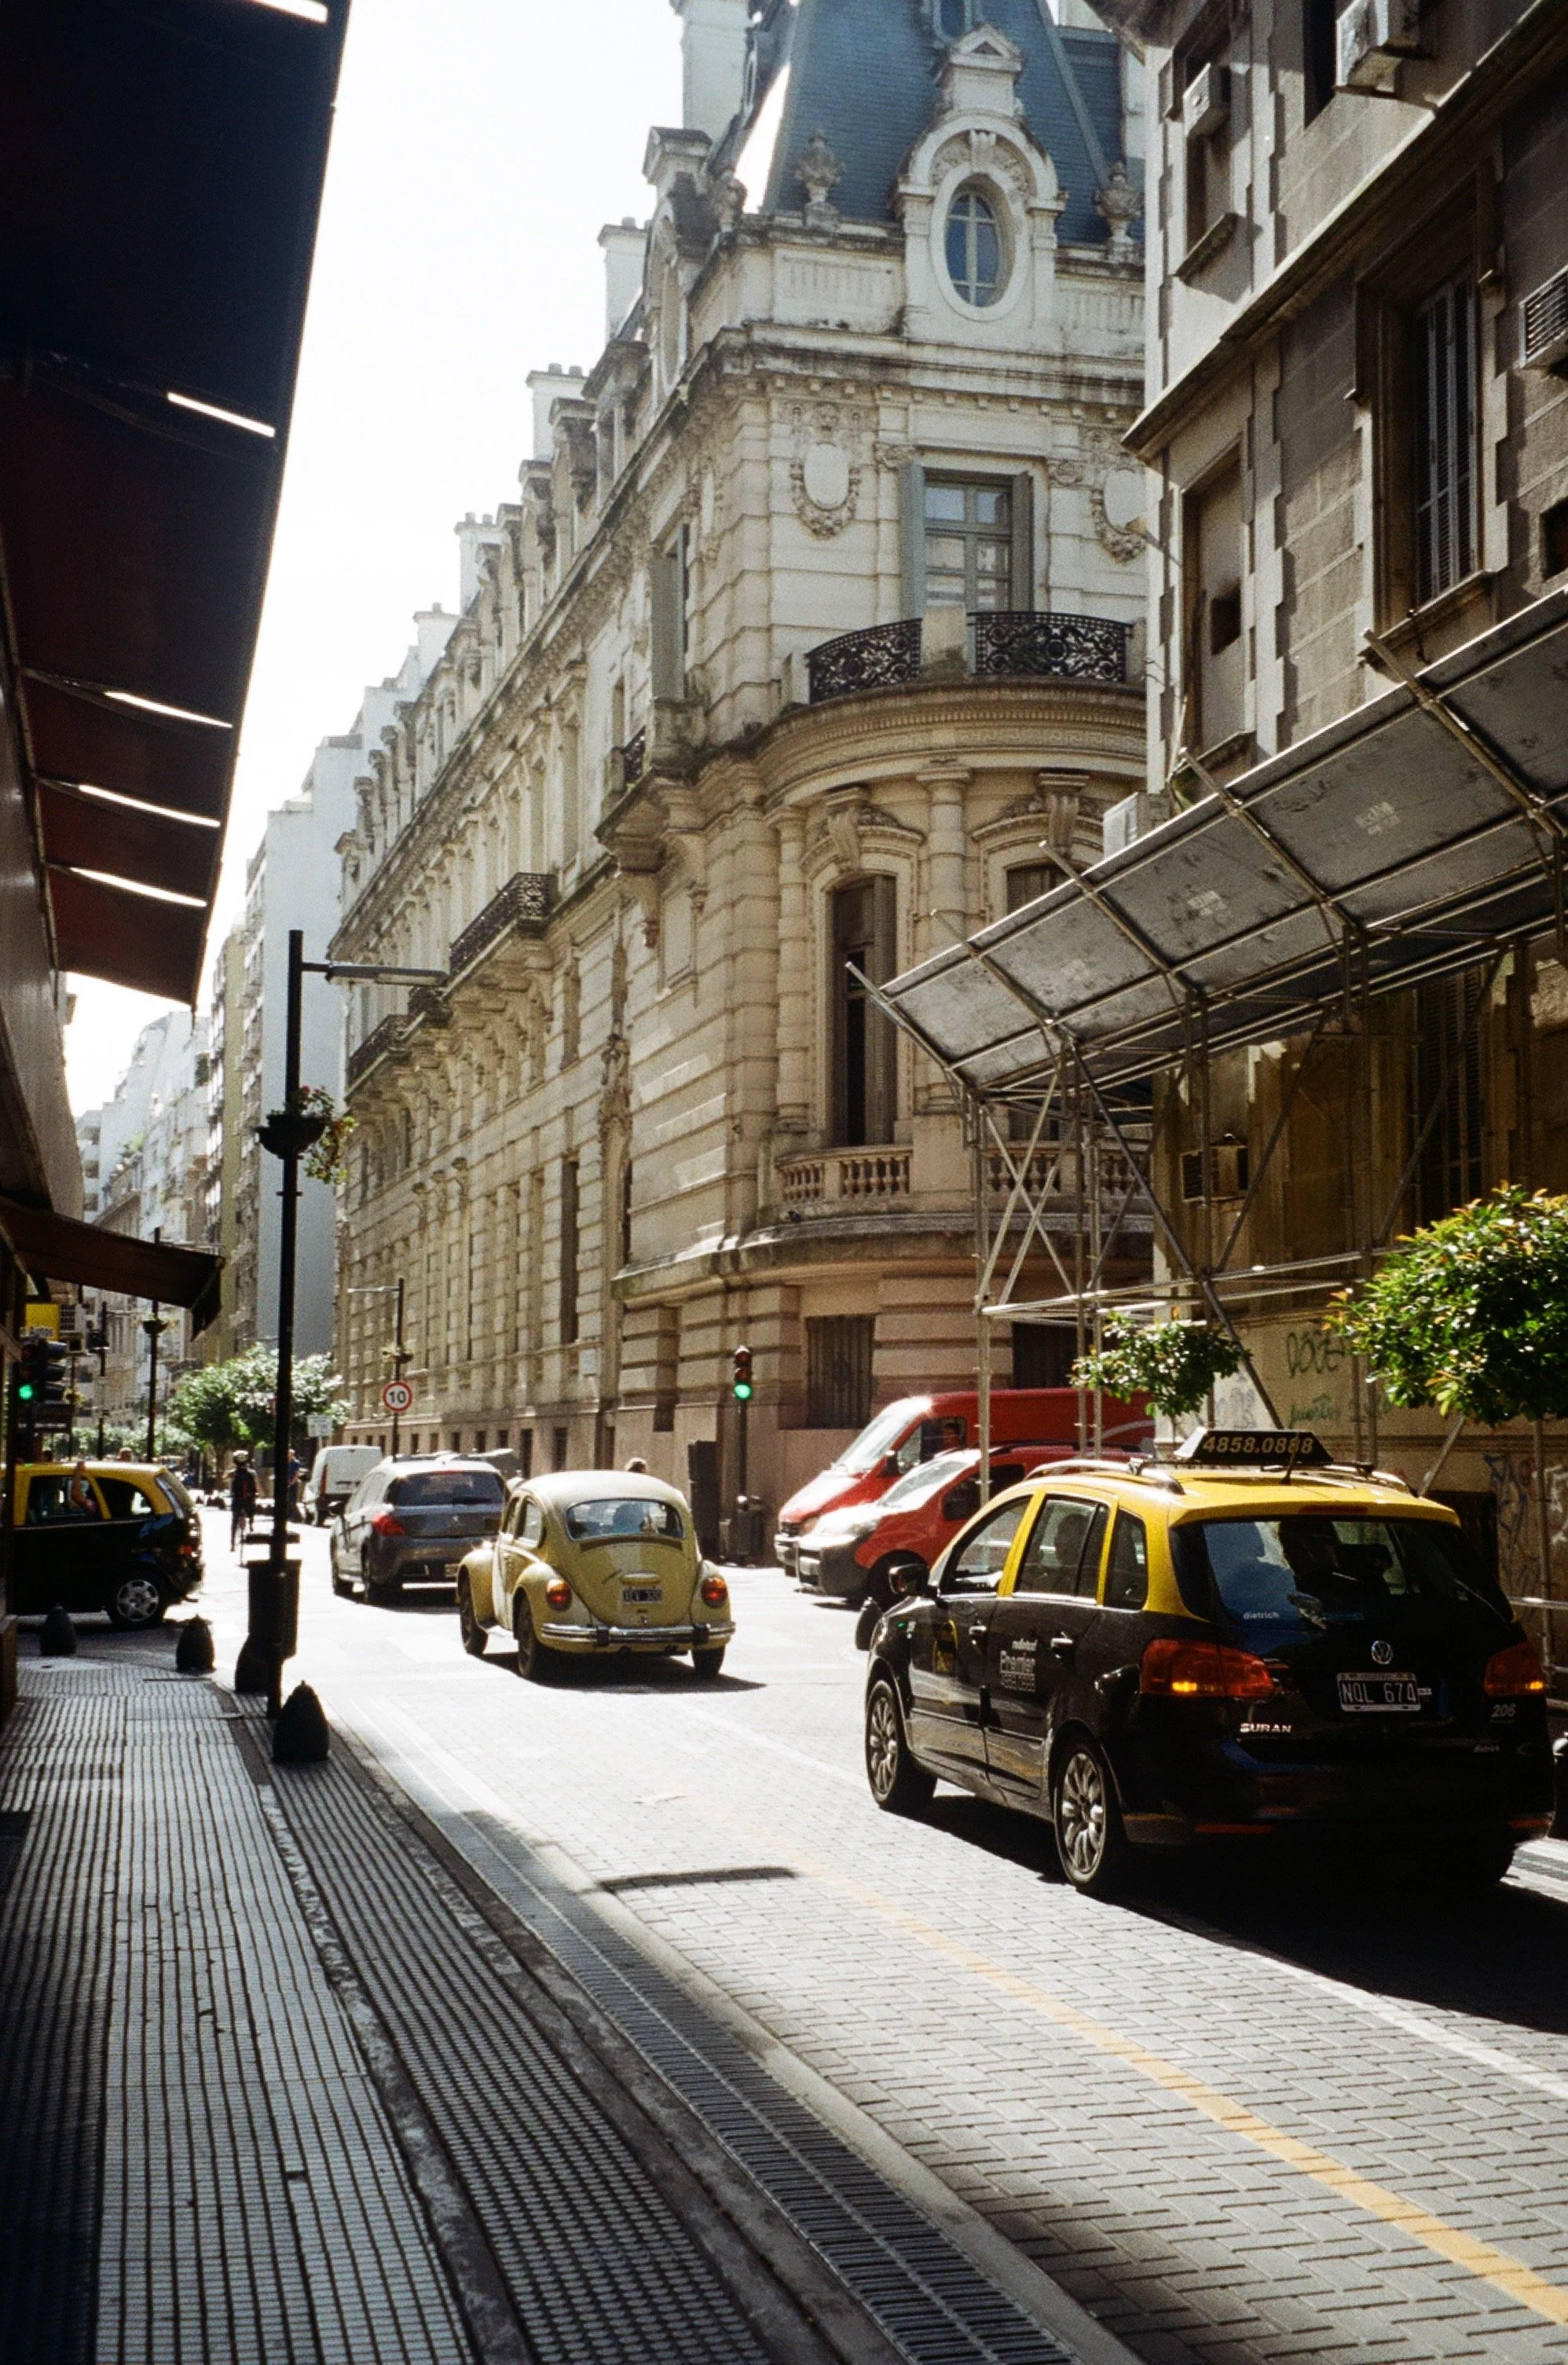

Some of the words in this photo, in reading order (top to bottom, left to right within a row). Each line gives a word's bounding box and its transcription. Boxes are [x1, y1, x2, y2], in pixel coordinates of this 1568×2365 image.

[388, 1391, 407, 1404] 10
[1202, 1436, 1313, 1454] 4858.0888
[1383, 1682, 1417, 1703] 674
[1240, 1722, 1292, 1733] SURAN
